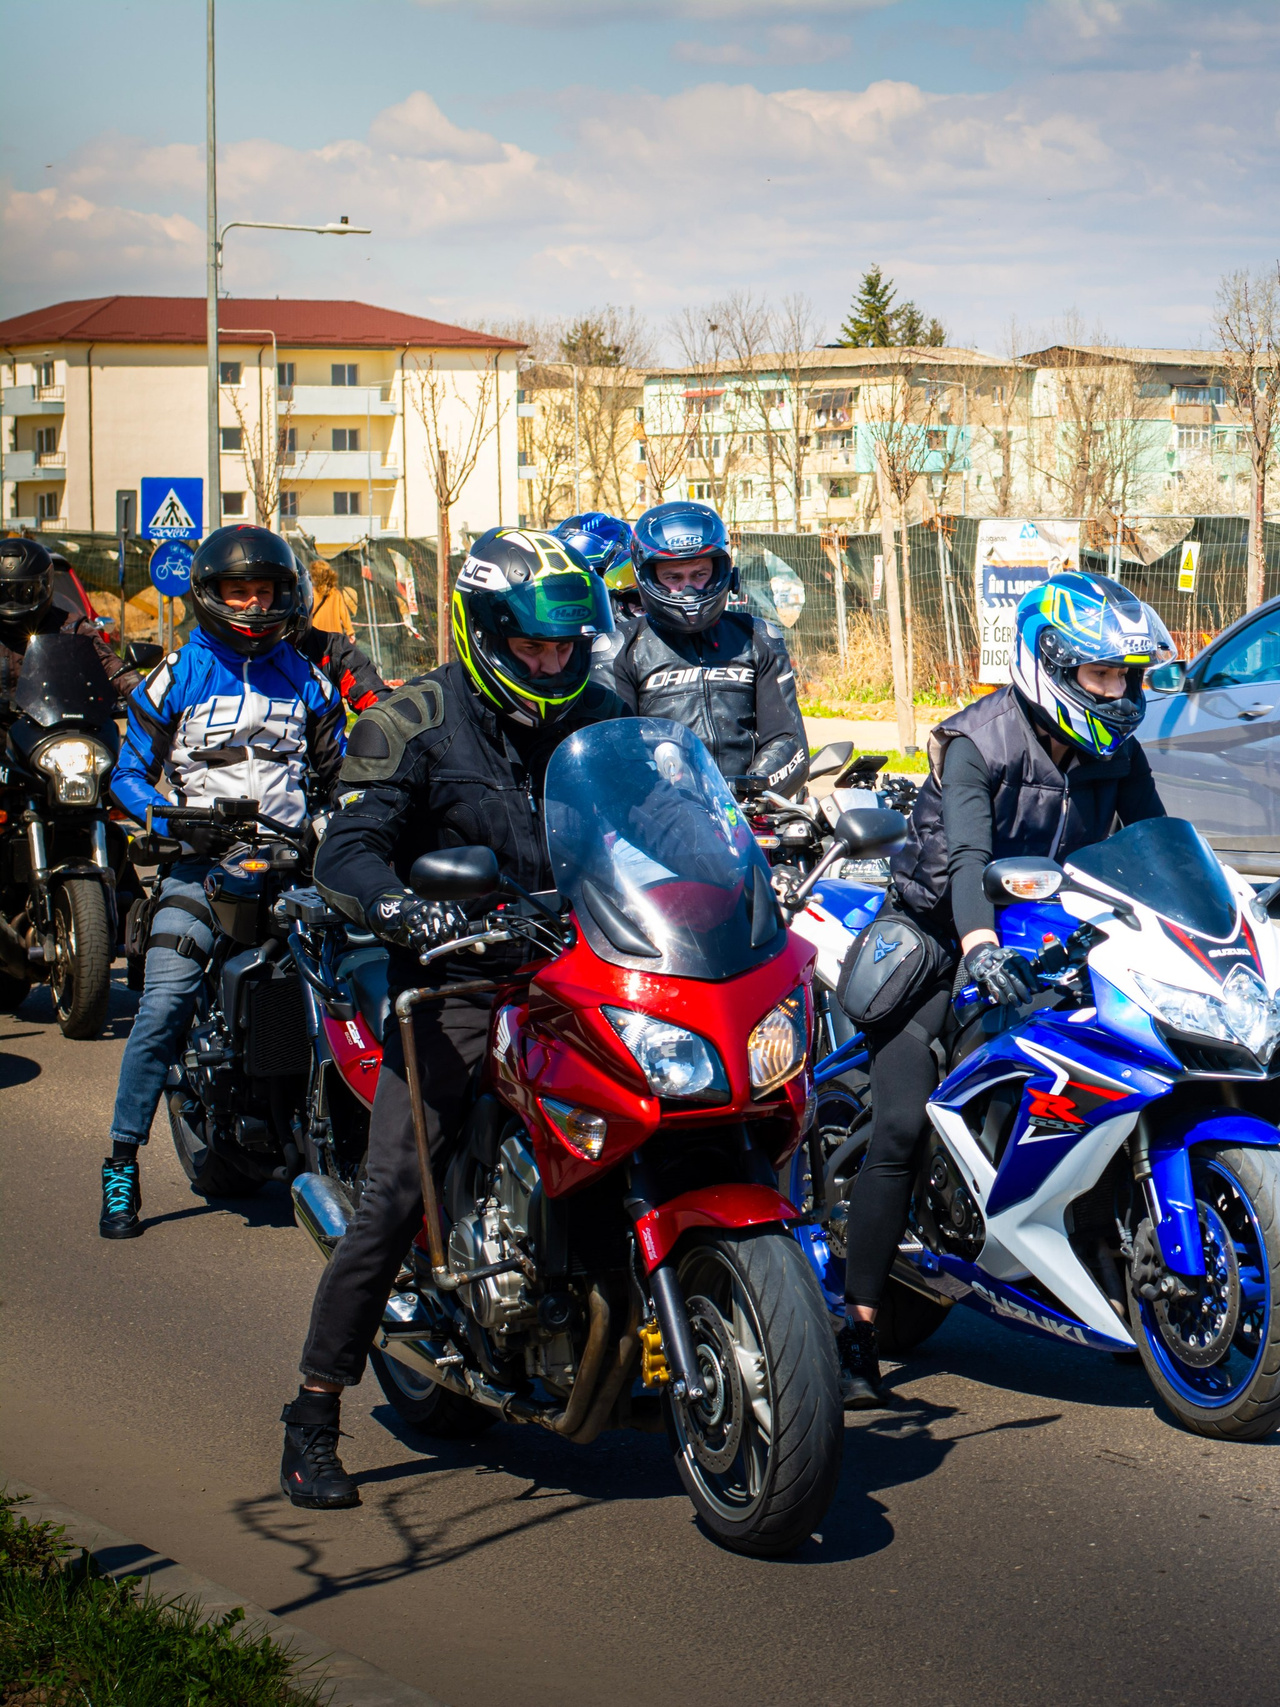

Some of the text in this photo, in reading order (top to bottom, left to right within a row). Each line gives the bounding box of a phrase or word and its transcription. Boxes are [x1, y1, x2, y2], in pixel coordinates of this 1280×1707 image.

[554, 605, 588, 619] HJC
[982, 649, 1009, 666] DISC
[646, 667, 756, 689] DAINESE
[768, 748, 806, 787] DAINESE
[1208, 947, 1252, 959] SUZUKI
[346, 1020, 366, 1049] CBF
[1028, 1115, 1086, 1133] GSX
[971, 1280, 1090, 1345] SUZUKI
